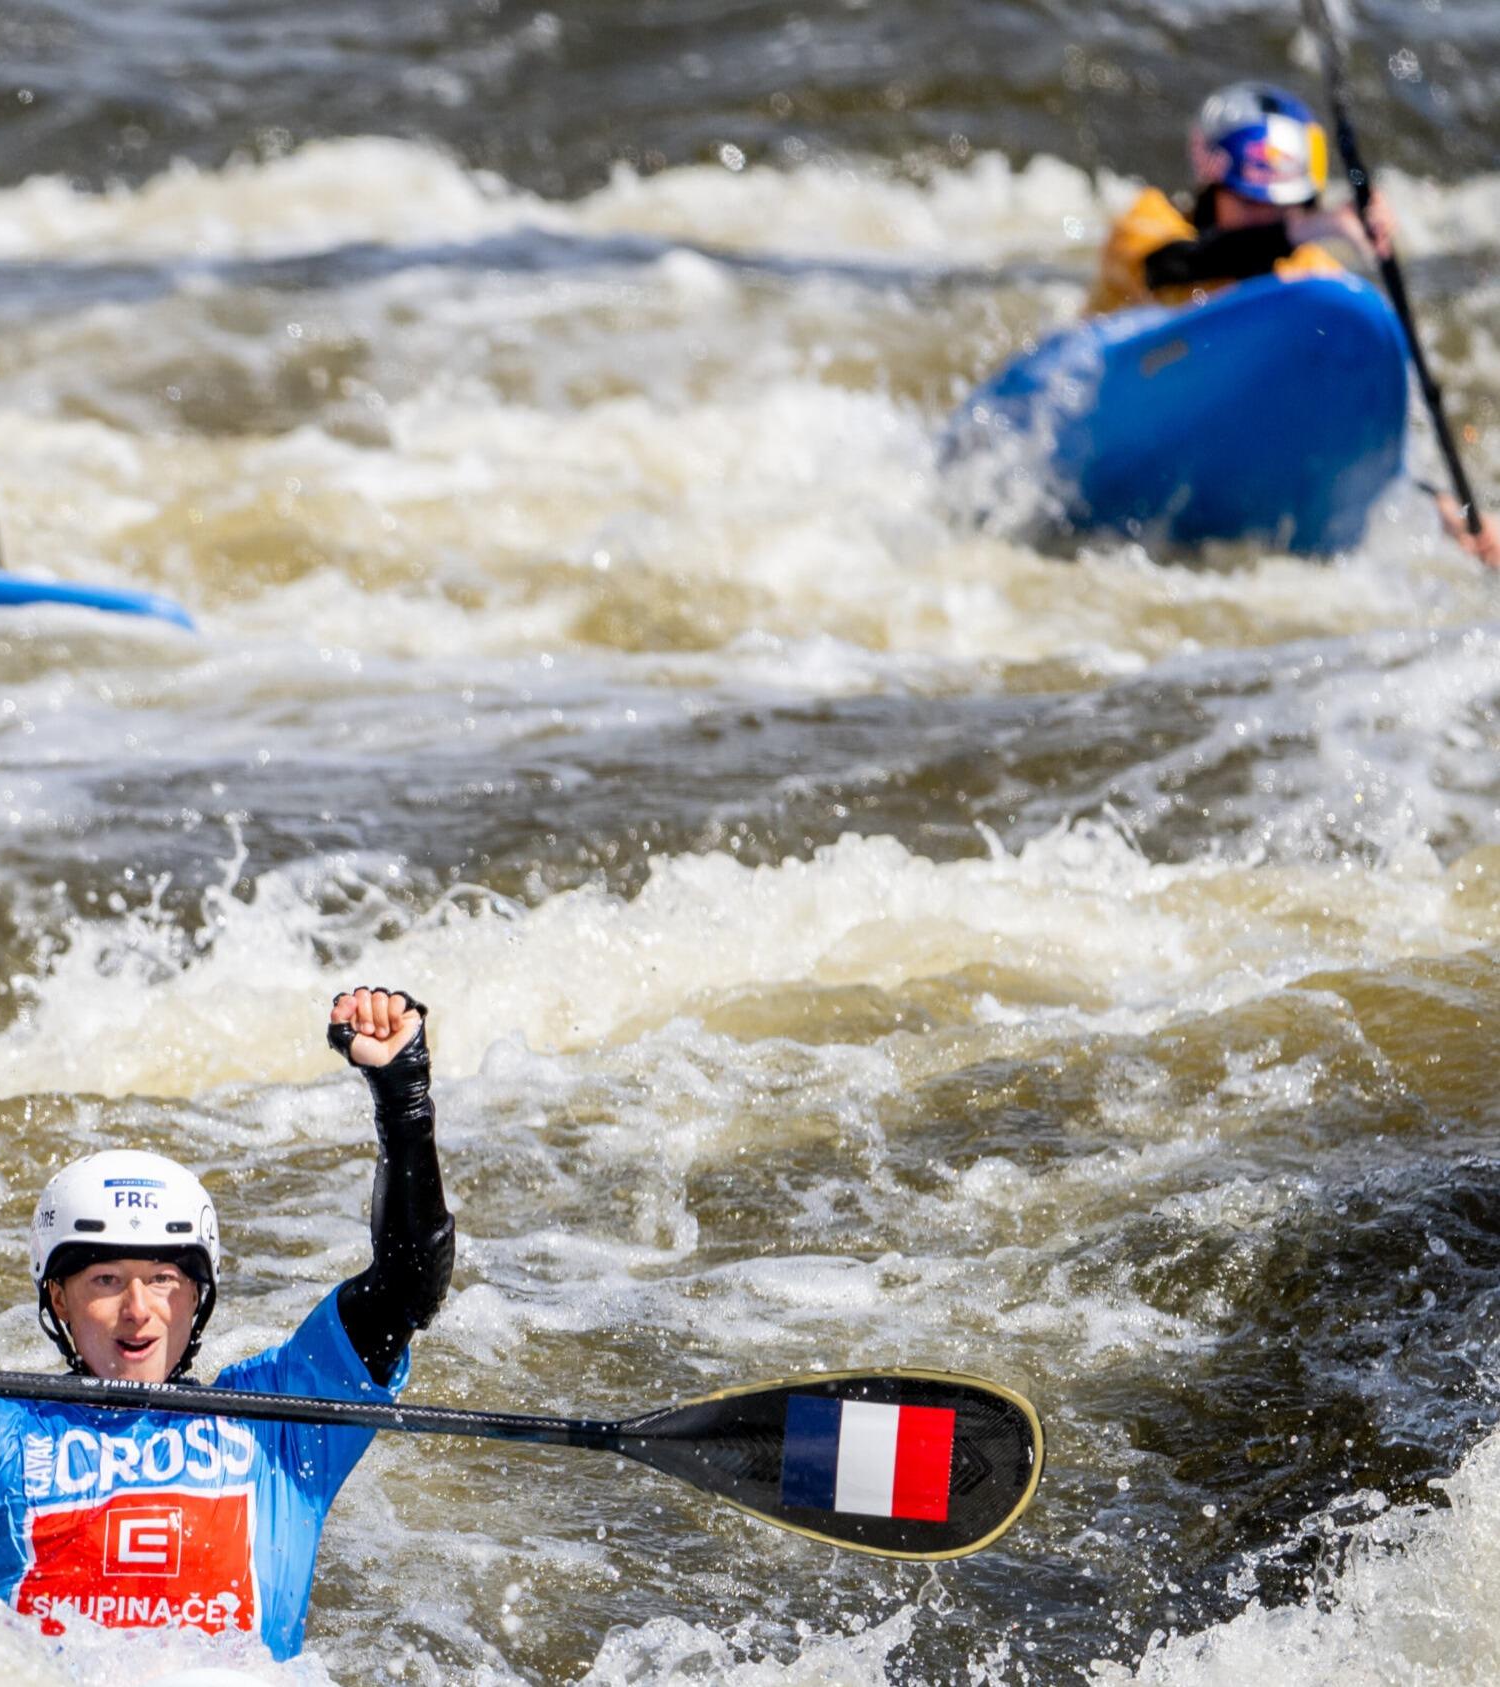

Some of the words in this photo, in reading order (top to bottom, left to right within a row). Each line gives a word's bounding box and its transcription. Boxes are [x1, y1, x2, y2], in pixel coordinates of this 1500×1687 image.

[114, 1191, 158, 1209] FRA
[103, 1379, 141, 1389] PARIS
[24, 1433, 52, 1498] KAYAK
[55, 1415, 255, 1493] CROSS
[32, 1595, 173, 1624] SKUPINA
